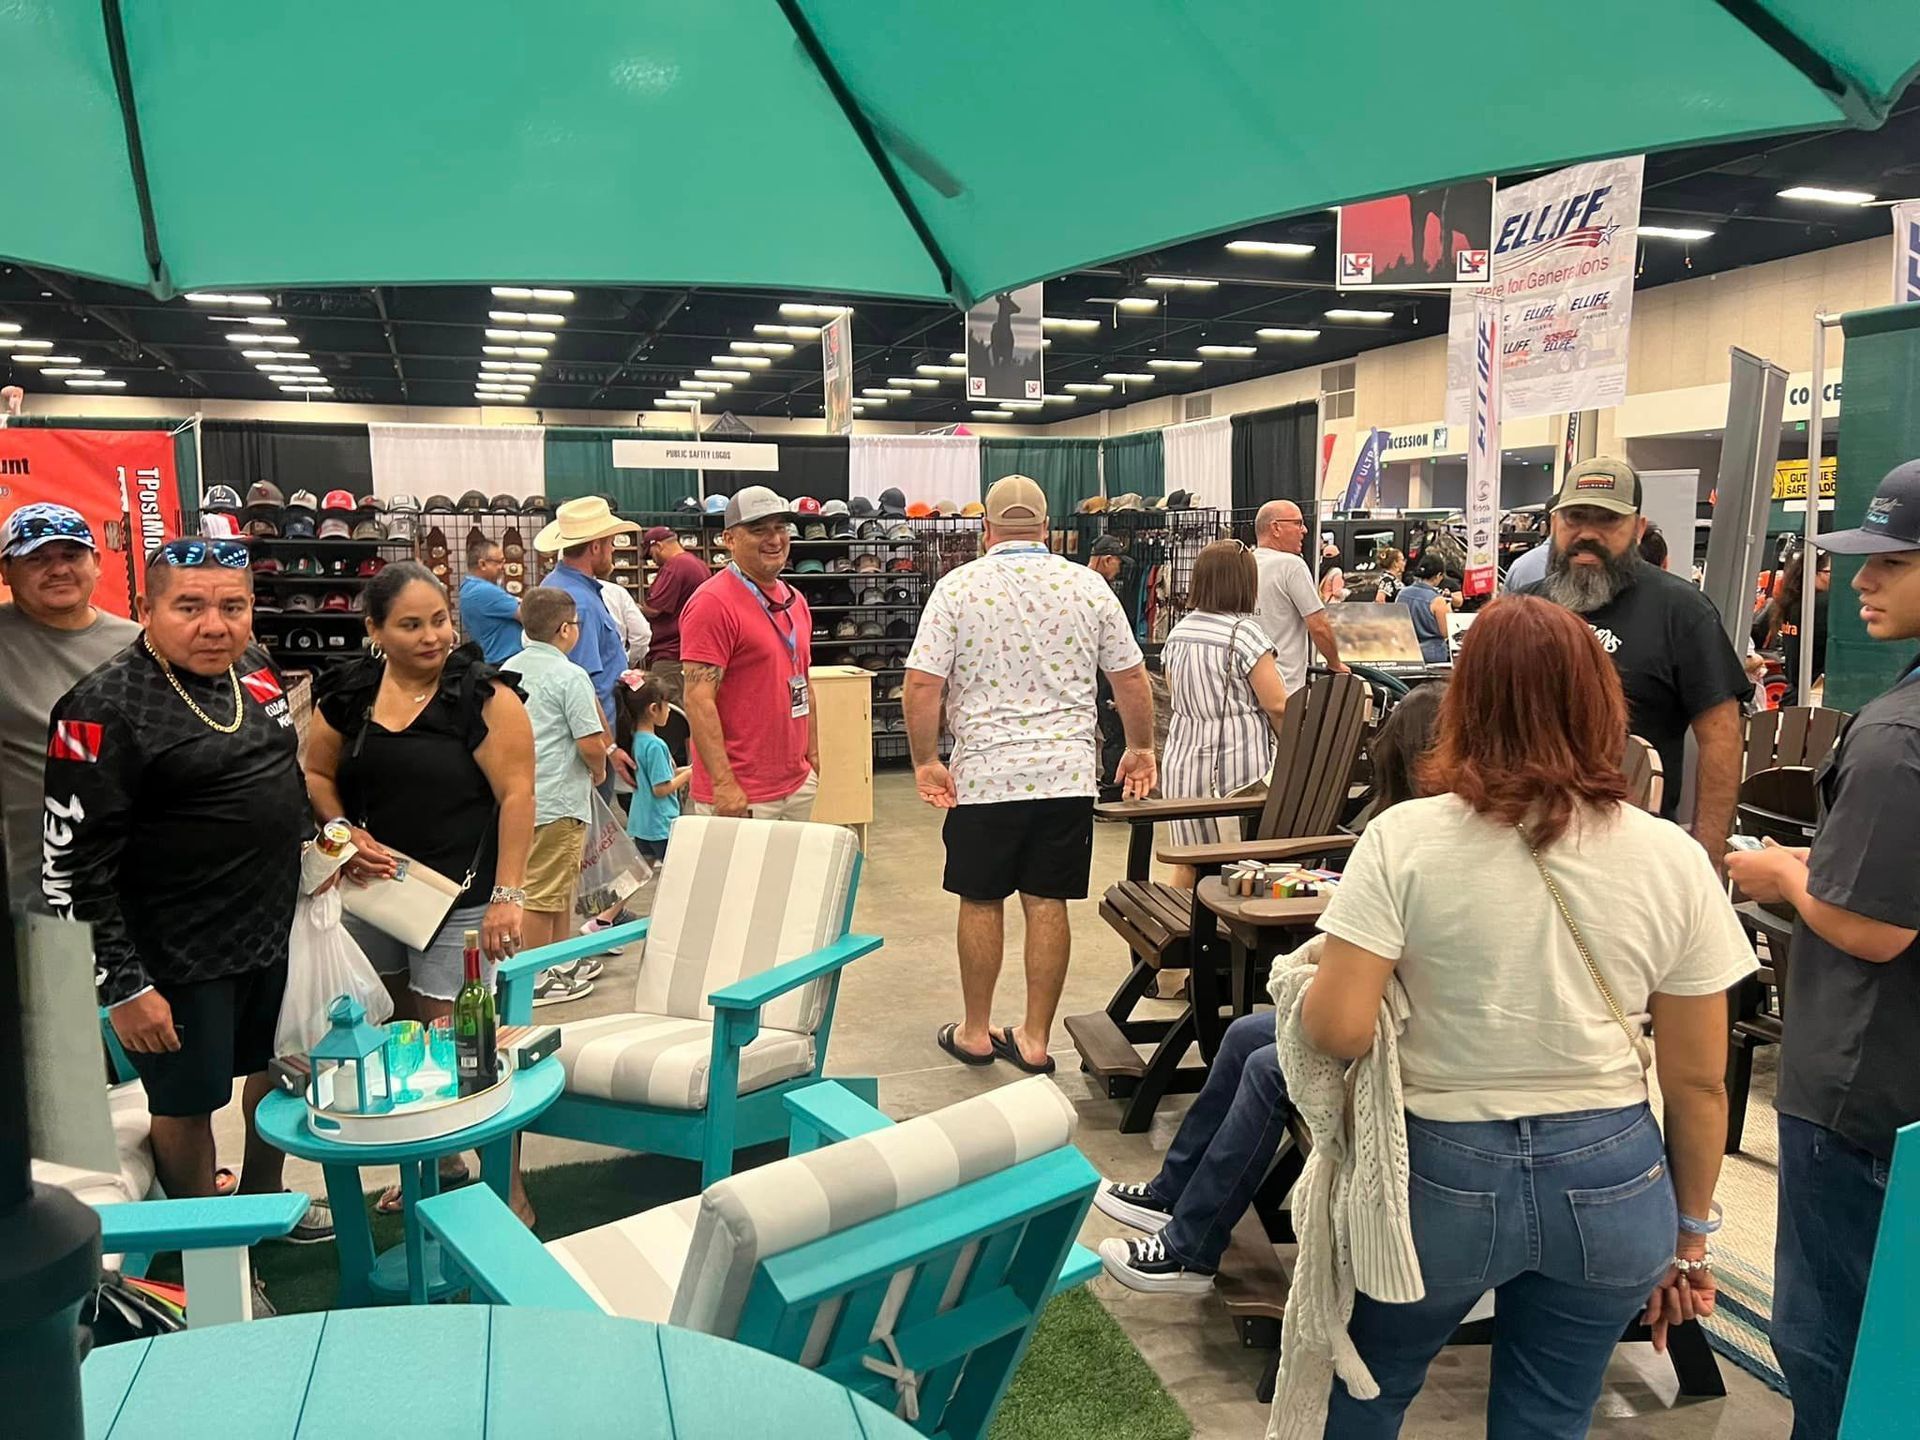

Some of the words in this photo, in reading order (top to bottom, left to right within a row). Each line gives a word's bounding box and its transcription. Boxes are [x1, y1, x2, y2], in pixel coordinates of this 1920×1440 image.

[1494, 185, 1612, 254] ELLIFF
[1527, 256, 1609, 290] Generaions
[1570, 291, 1610, 311] ELLIFF
[1503, 339, 1531, 354] LLIFF
[1789, 383, 1843, 405] COCE
[665, 449, 687, 458] PUBLIC
[712, 451, 731, 459] LOGOS
[1786, 484, 1807, 494] SAFE
